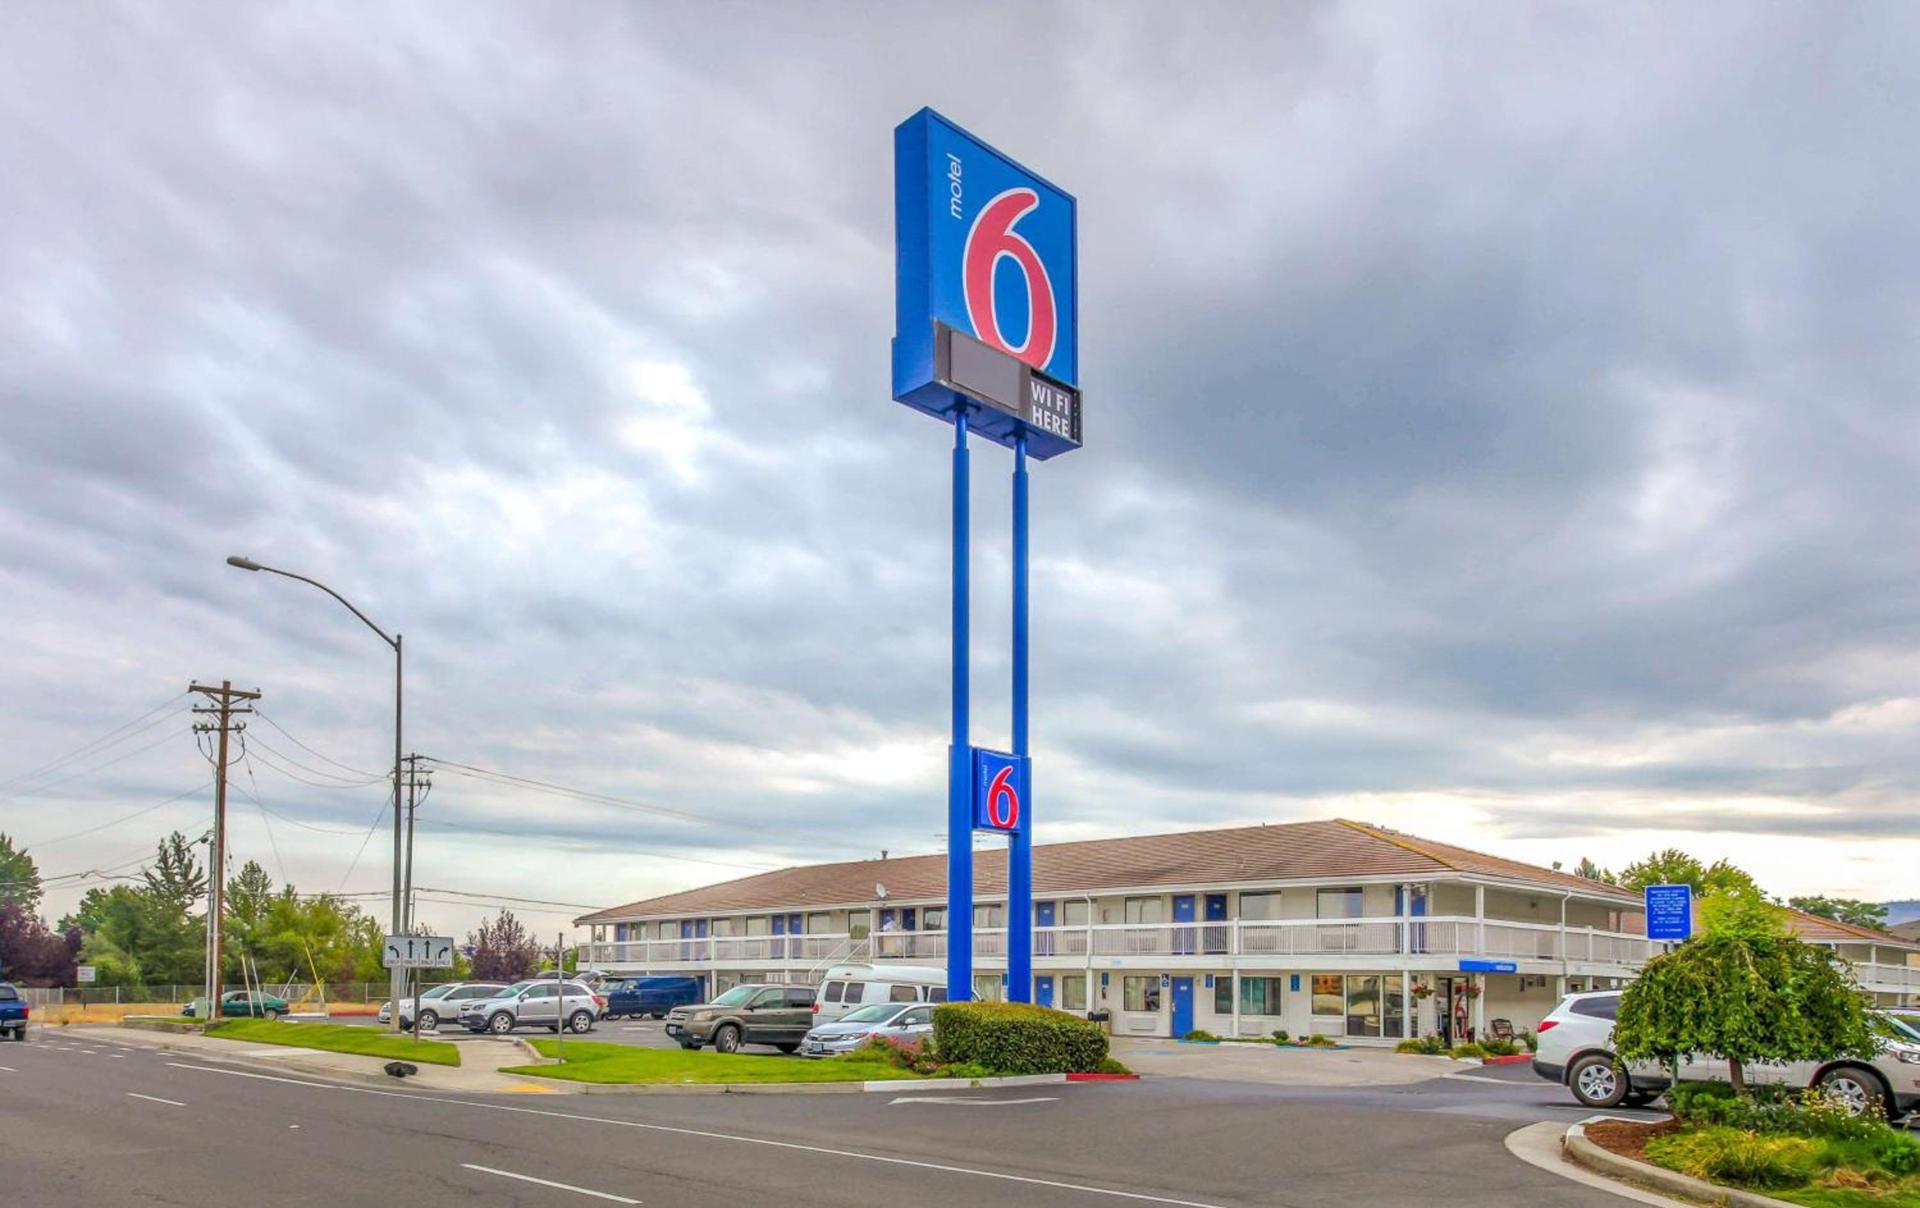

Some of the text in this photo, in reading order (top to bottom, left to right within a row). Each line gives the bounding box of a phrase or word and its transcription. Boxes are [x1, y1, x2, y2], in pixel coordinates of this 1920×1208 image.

[946, 152, 962, 219] motel
[962, 187, 1057, 371] 6
[1031, 380, 1069, 415] WI FI
[1032, 404, 1069, 438] HERE
[986, 765, 1019, 829] 6
